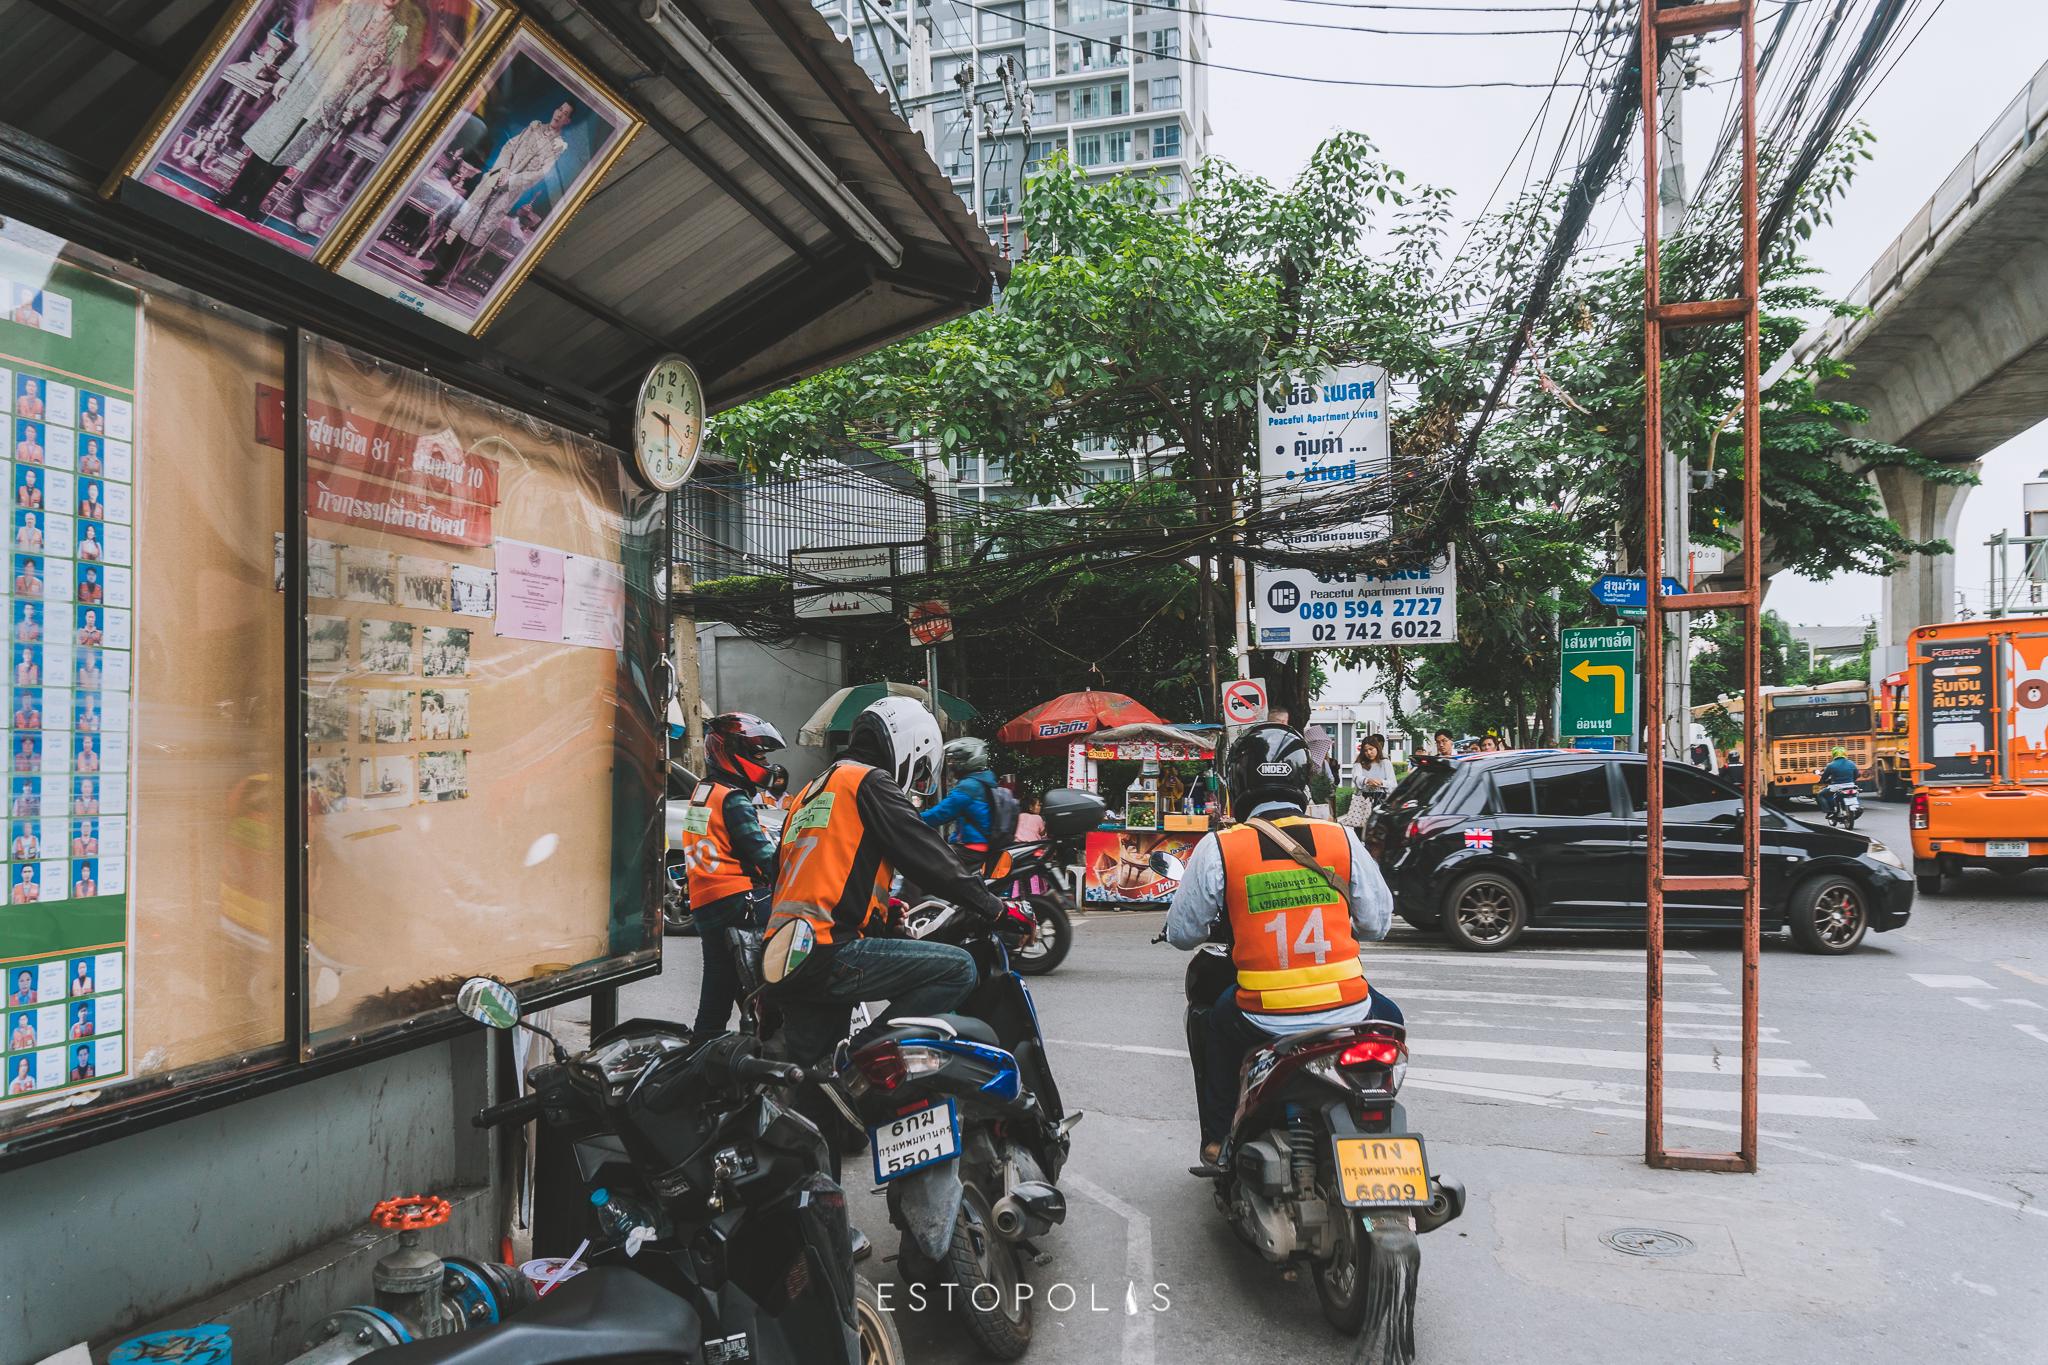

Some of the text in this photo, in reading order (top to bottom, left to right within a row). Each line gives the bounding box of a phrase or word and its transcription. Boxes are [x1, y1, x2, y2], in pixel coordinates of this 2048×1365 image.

[1323, 381, 1376, 403] เพลส
[1268, 409, 1379, 426] Peaceful Apartment Living
[371, 437, 391, 462] 81
[467, 464, 484, 489] 10
[316, 480, 466, 537] กิจกรรมเพื่อสังคม
[1310, 584, 1445, 600] Peaceful Apartment Living
[1603, 578, 1640, 594] สุขุมวิท
[1300, 597, 1442, 620] 080 594 2727
[1312, 619, 1442, 641] 02 742 6022
[1565, 631, 1632, 649] เส้นทางลัด
[1932, 648, 1981, 657] KERRY
[1932, 679, 1981, 693] รับเงิน
[1932, 693, 1956, 708] คืน
[1039, 720, 1088, 737] โอวัลติน
[1576, 717, 1613, 733] อ่อนนุช
[1261, 763, 1289, 774] INDEX
[1259, 893, 1331, 910] เขตสวนหลวง
[1264, 907, 1332, 969] 14
[879, 1125, 952, 1158] กรุงเทพมหานคร
[888, 1143, 942, 1174] 5501
[1358, 1142, 1402, 1160] 1กง
[1344, 1166, 1422, 1180] กรุงเทพมหานคร
[1356, 1184, 1416, 1201] 6609
